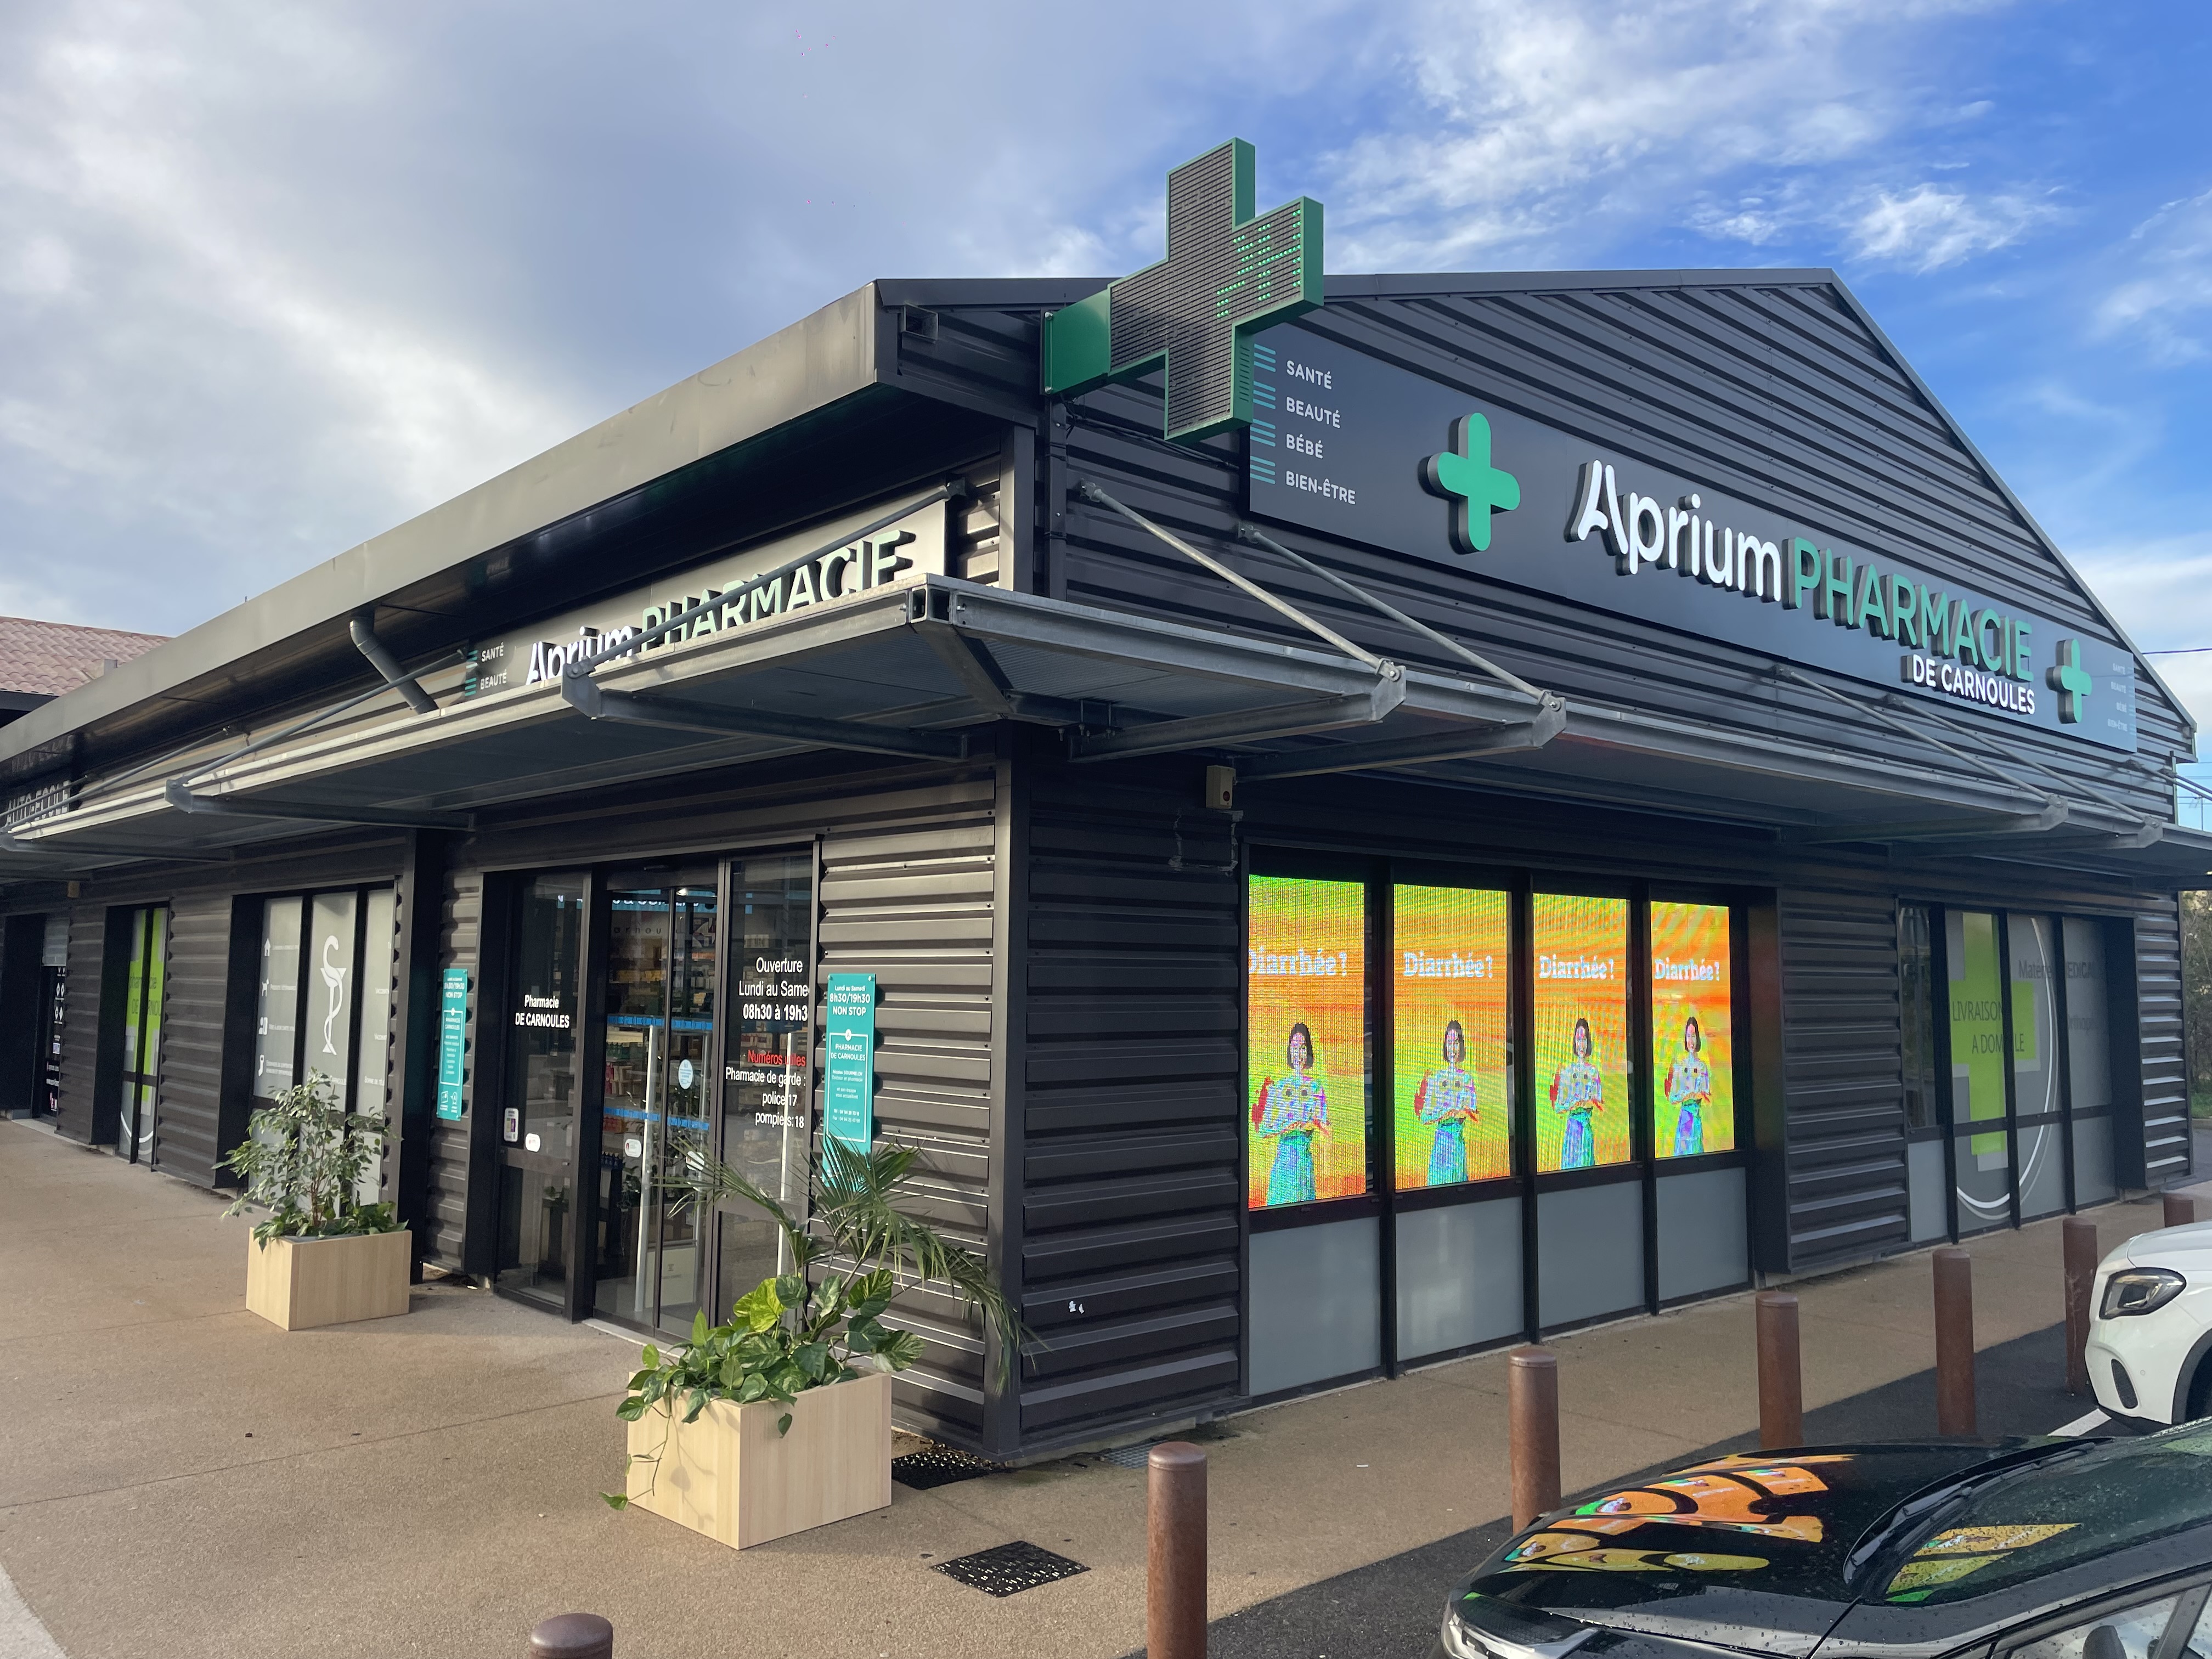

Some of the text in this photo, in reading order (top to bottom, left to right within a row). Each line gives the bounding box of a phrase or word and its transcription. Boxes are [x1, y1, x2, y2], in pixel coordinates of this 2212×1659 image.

[1286, 360, 1332, 390] SANTÉ
[1286, 397, 1341, 428] BEAUTÉ
[1286, 433, 1323, 459] BÉBÉ
[1286, 470, 1356, 505] BIEN-ÊTRE
[1793, 536, 2034, 682] PHARMACIE
[481, 641, 504, 662] SANTÉ
[479, 669, 507, 690] BEAUTÉ
[1912, 653, 2035, 715] DE CARNOULES
[756, 957, 803, 973] Ouverture
[738, 980, 764, 996] Lundi
[766, 984, 778, 996] au
[524, 994, 559, 1009] Pharmacie
[830, 992, 871, 1005] 8h30/19h30
[743, 1003, 772, 1020] 08h30
[774, 1004, 781, 1020] à
[832, 1006, 866, 1016] NON STOP
[515, 1012, 570, 1029] DE CARNOULES
[835, 1043, 862, 1052] PHARMACIE
[748, 1049, 783, 1065] Numéros
[837, 1052, 866, 1062] CARNOULES
[725, 1066, 765, 1083] Pharmacie
[766, 1070, 777, 1084] de
[762, 1091, 786, 1107] police
